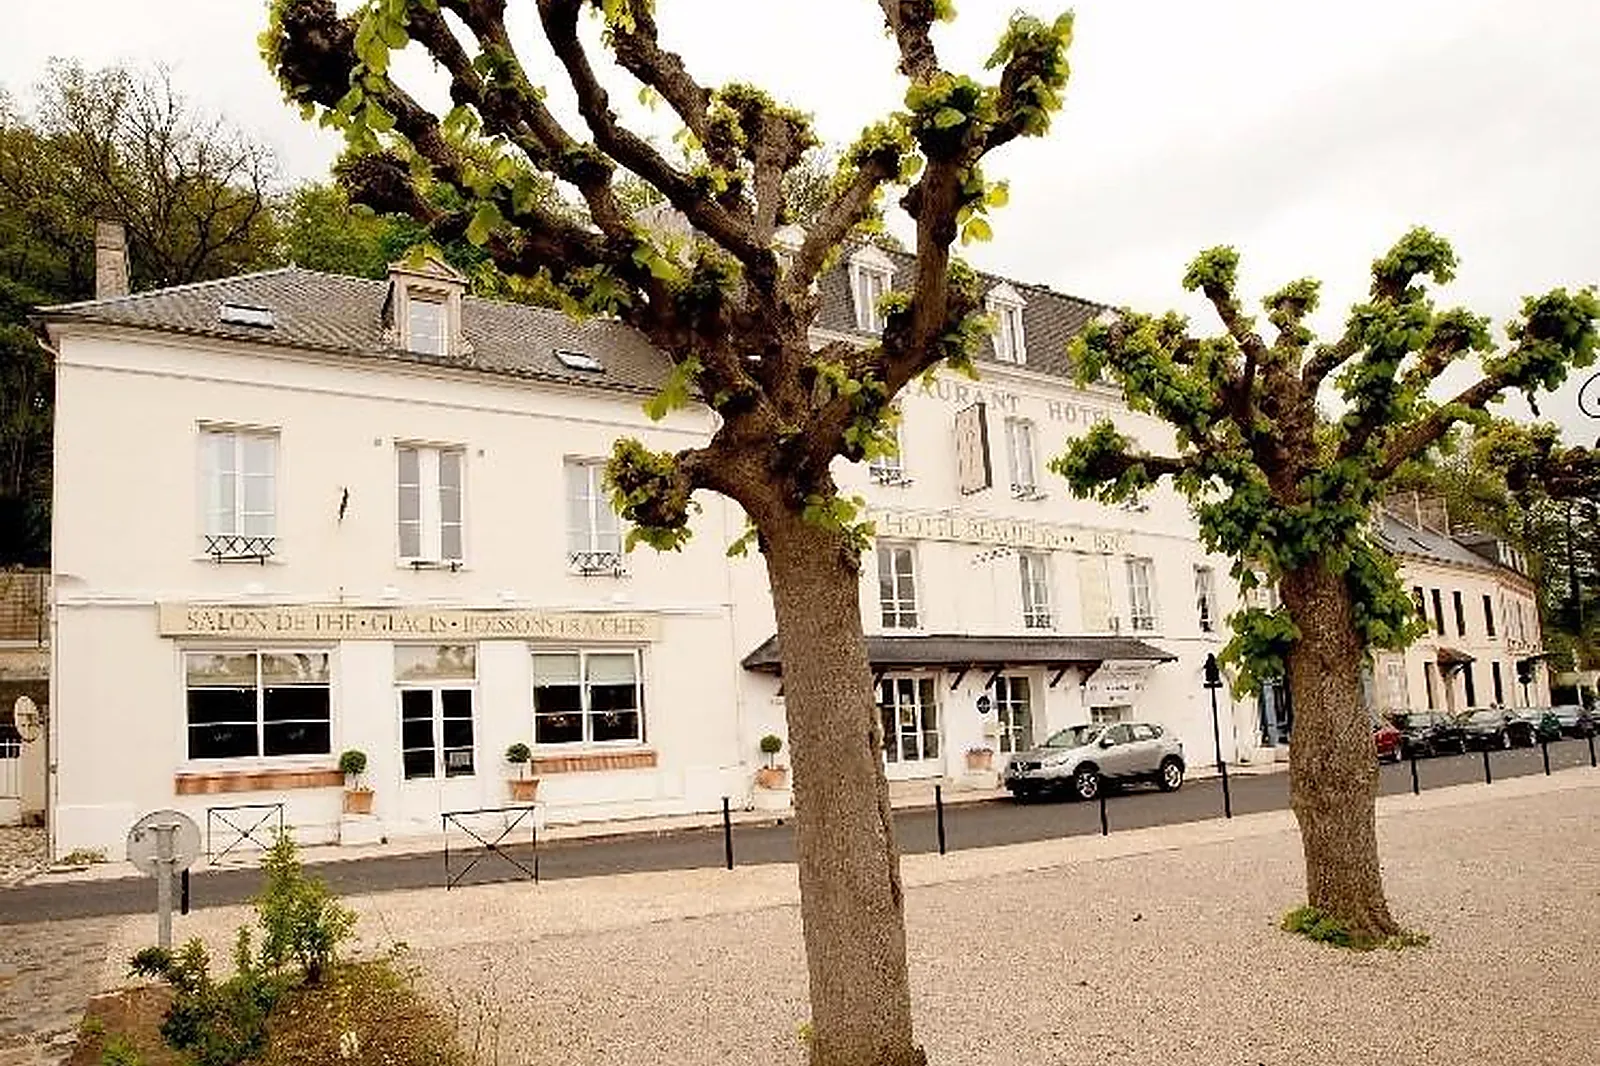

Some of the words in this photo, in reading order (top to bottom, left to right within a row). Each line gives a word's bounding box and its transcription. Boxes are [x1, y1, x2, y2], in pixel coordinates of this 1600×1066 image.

[902, 377, 1020, 412] AURANT
[187, 611, 268, 631] SALON
[276, 612, 306, 631] DE
